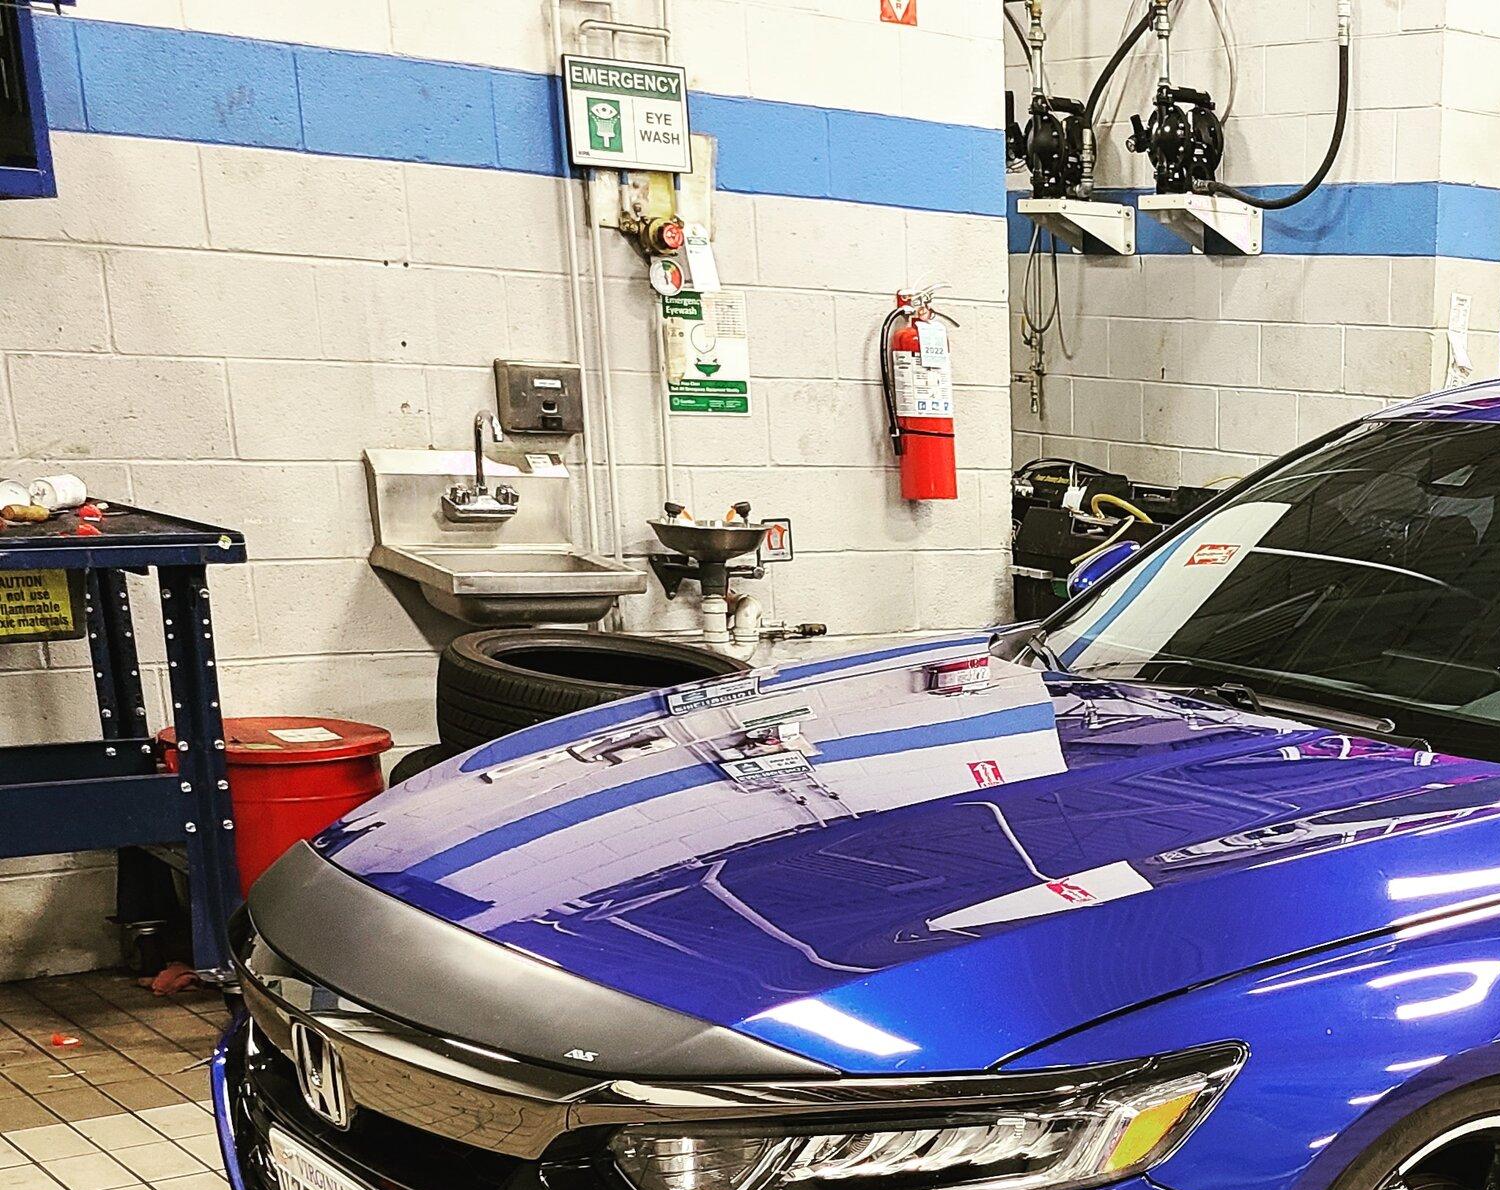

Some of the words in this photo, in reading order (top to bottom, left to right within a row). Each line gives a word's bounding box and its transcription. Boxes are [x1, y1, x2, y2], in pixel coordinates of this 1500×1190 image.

[571, 65, 679, 94] EMERGENCY
[645, 111, 672, 126] EYE
[639, 129, 680, 145] WASH
[664, 296, 701, 307] Emergenc
[665, 305, 697, 316] Eyewash
[925, 346, 944, 355] 2022
[0, 576, 42, 588] AUTION
[6, 589, 25, 601] not
[30, 590, 50, 601] use
[17, 614, 69, 627] materials
